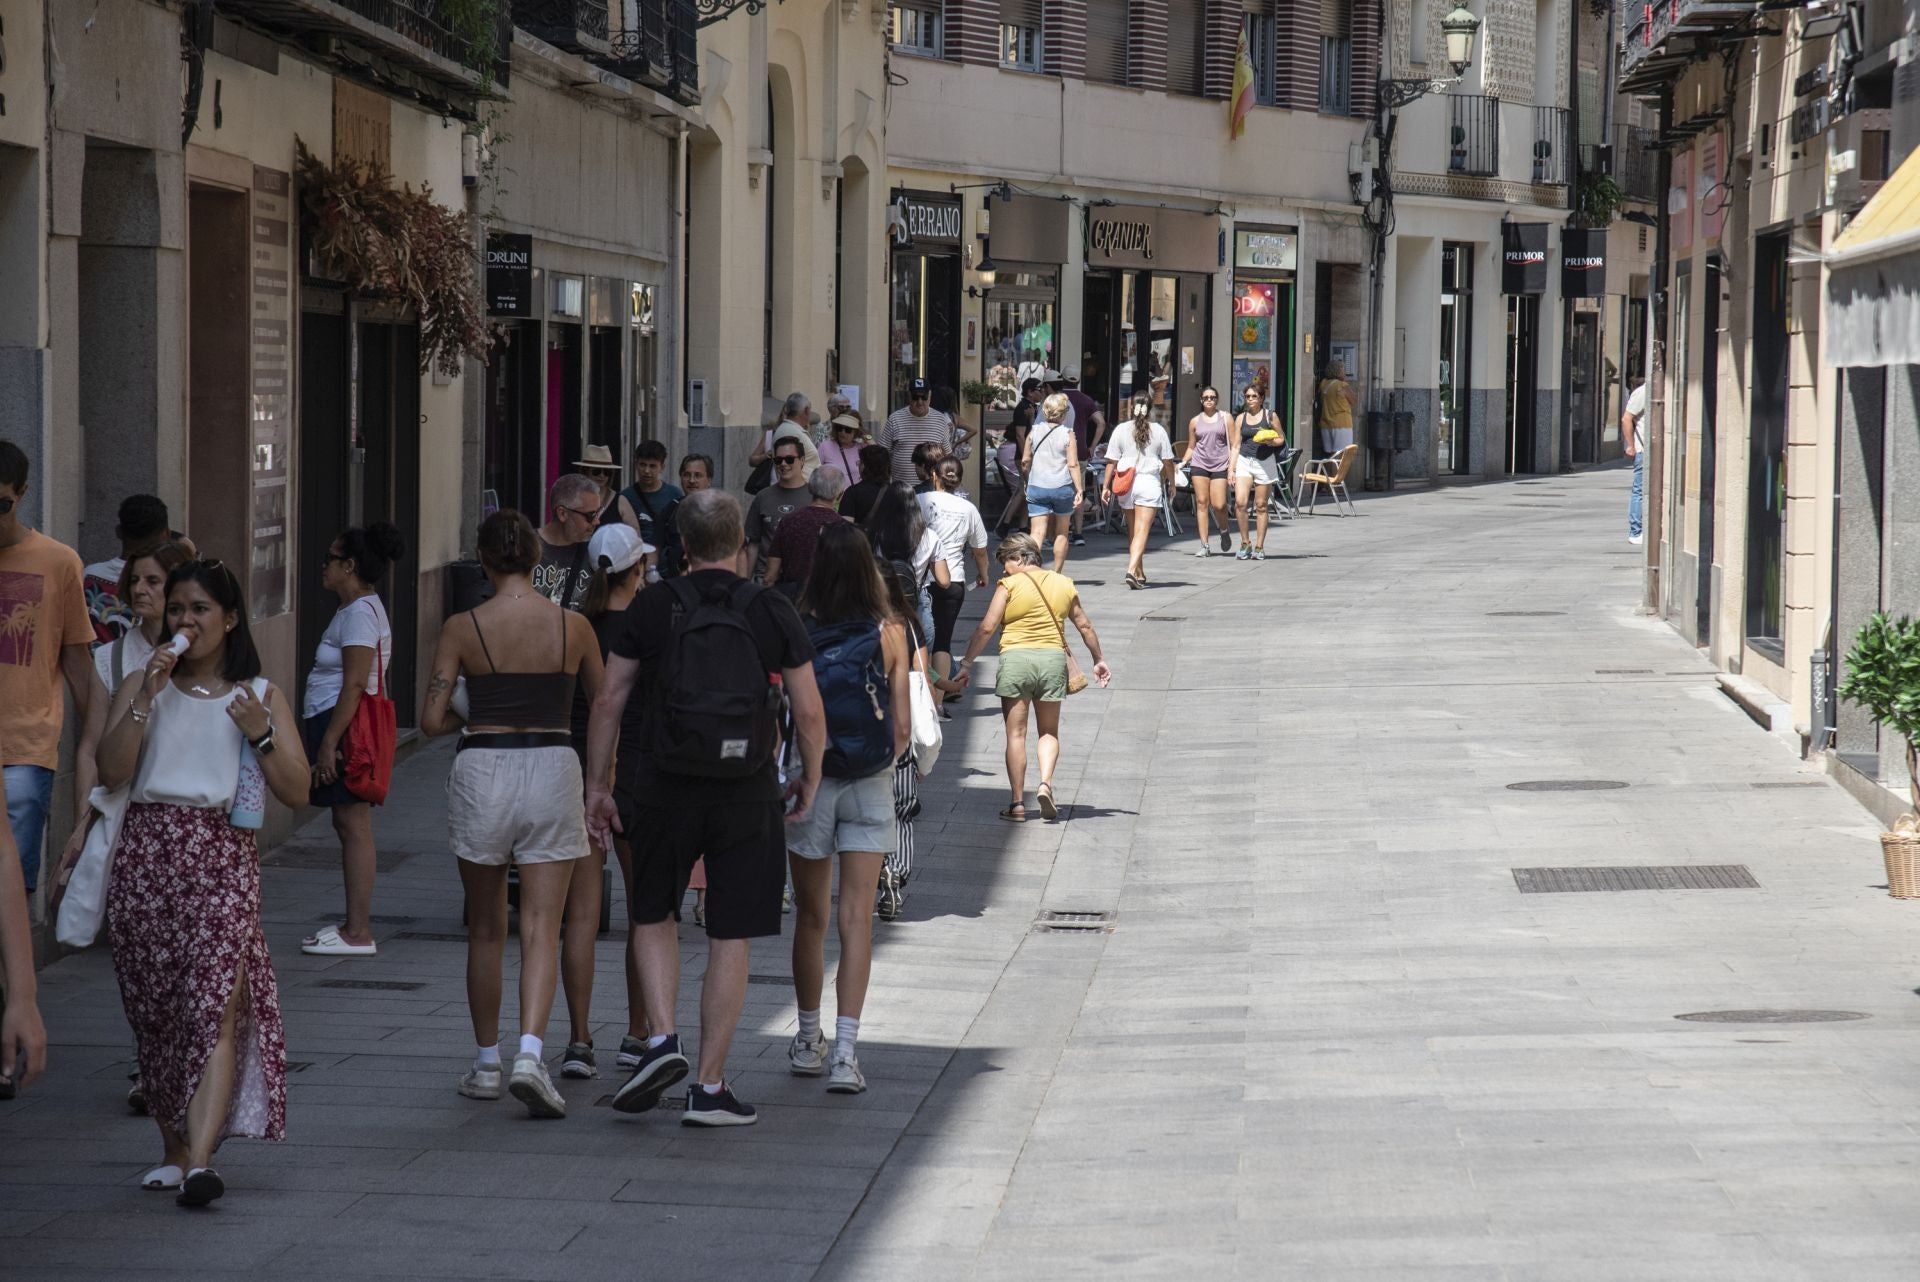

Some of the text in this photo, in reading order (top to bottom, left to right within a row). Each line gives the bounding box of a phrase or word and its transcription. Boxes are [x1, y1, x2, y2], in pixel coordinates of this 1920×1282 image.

[896, 195, 960, 244] SERRANO
[1095, 219, 1152, 258] GRANIER
[487, 251, 527, 263] DRUNI
[1506, 251, 1544, 261] PRIMOR
[1564, 257, 1603, 266] PRIMOR
[531, 563, 590, 593] AC/C
